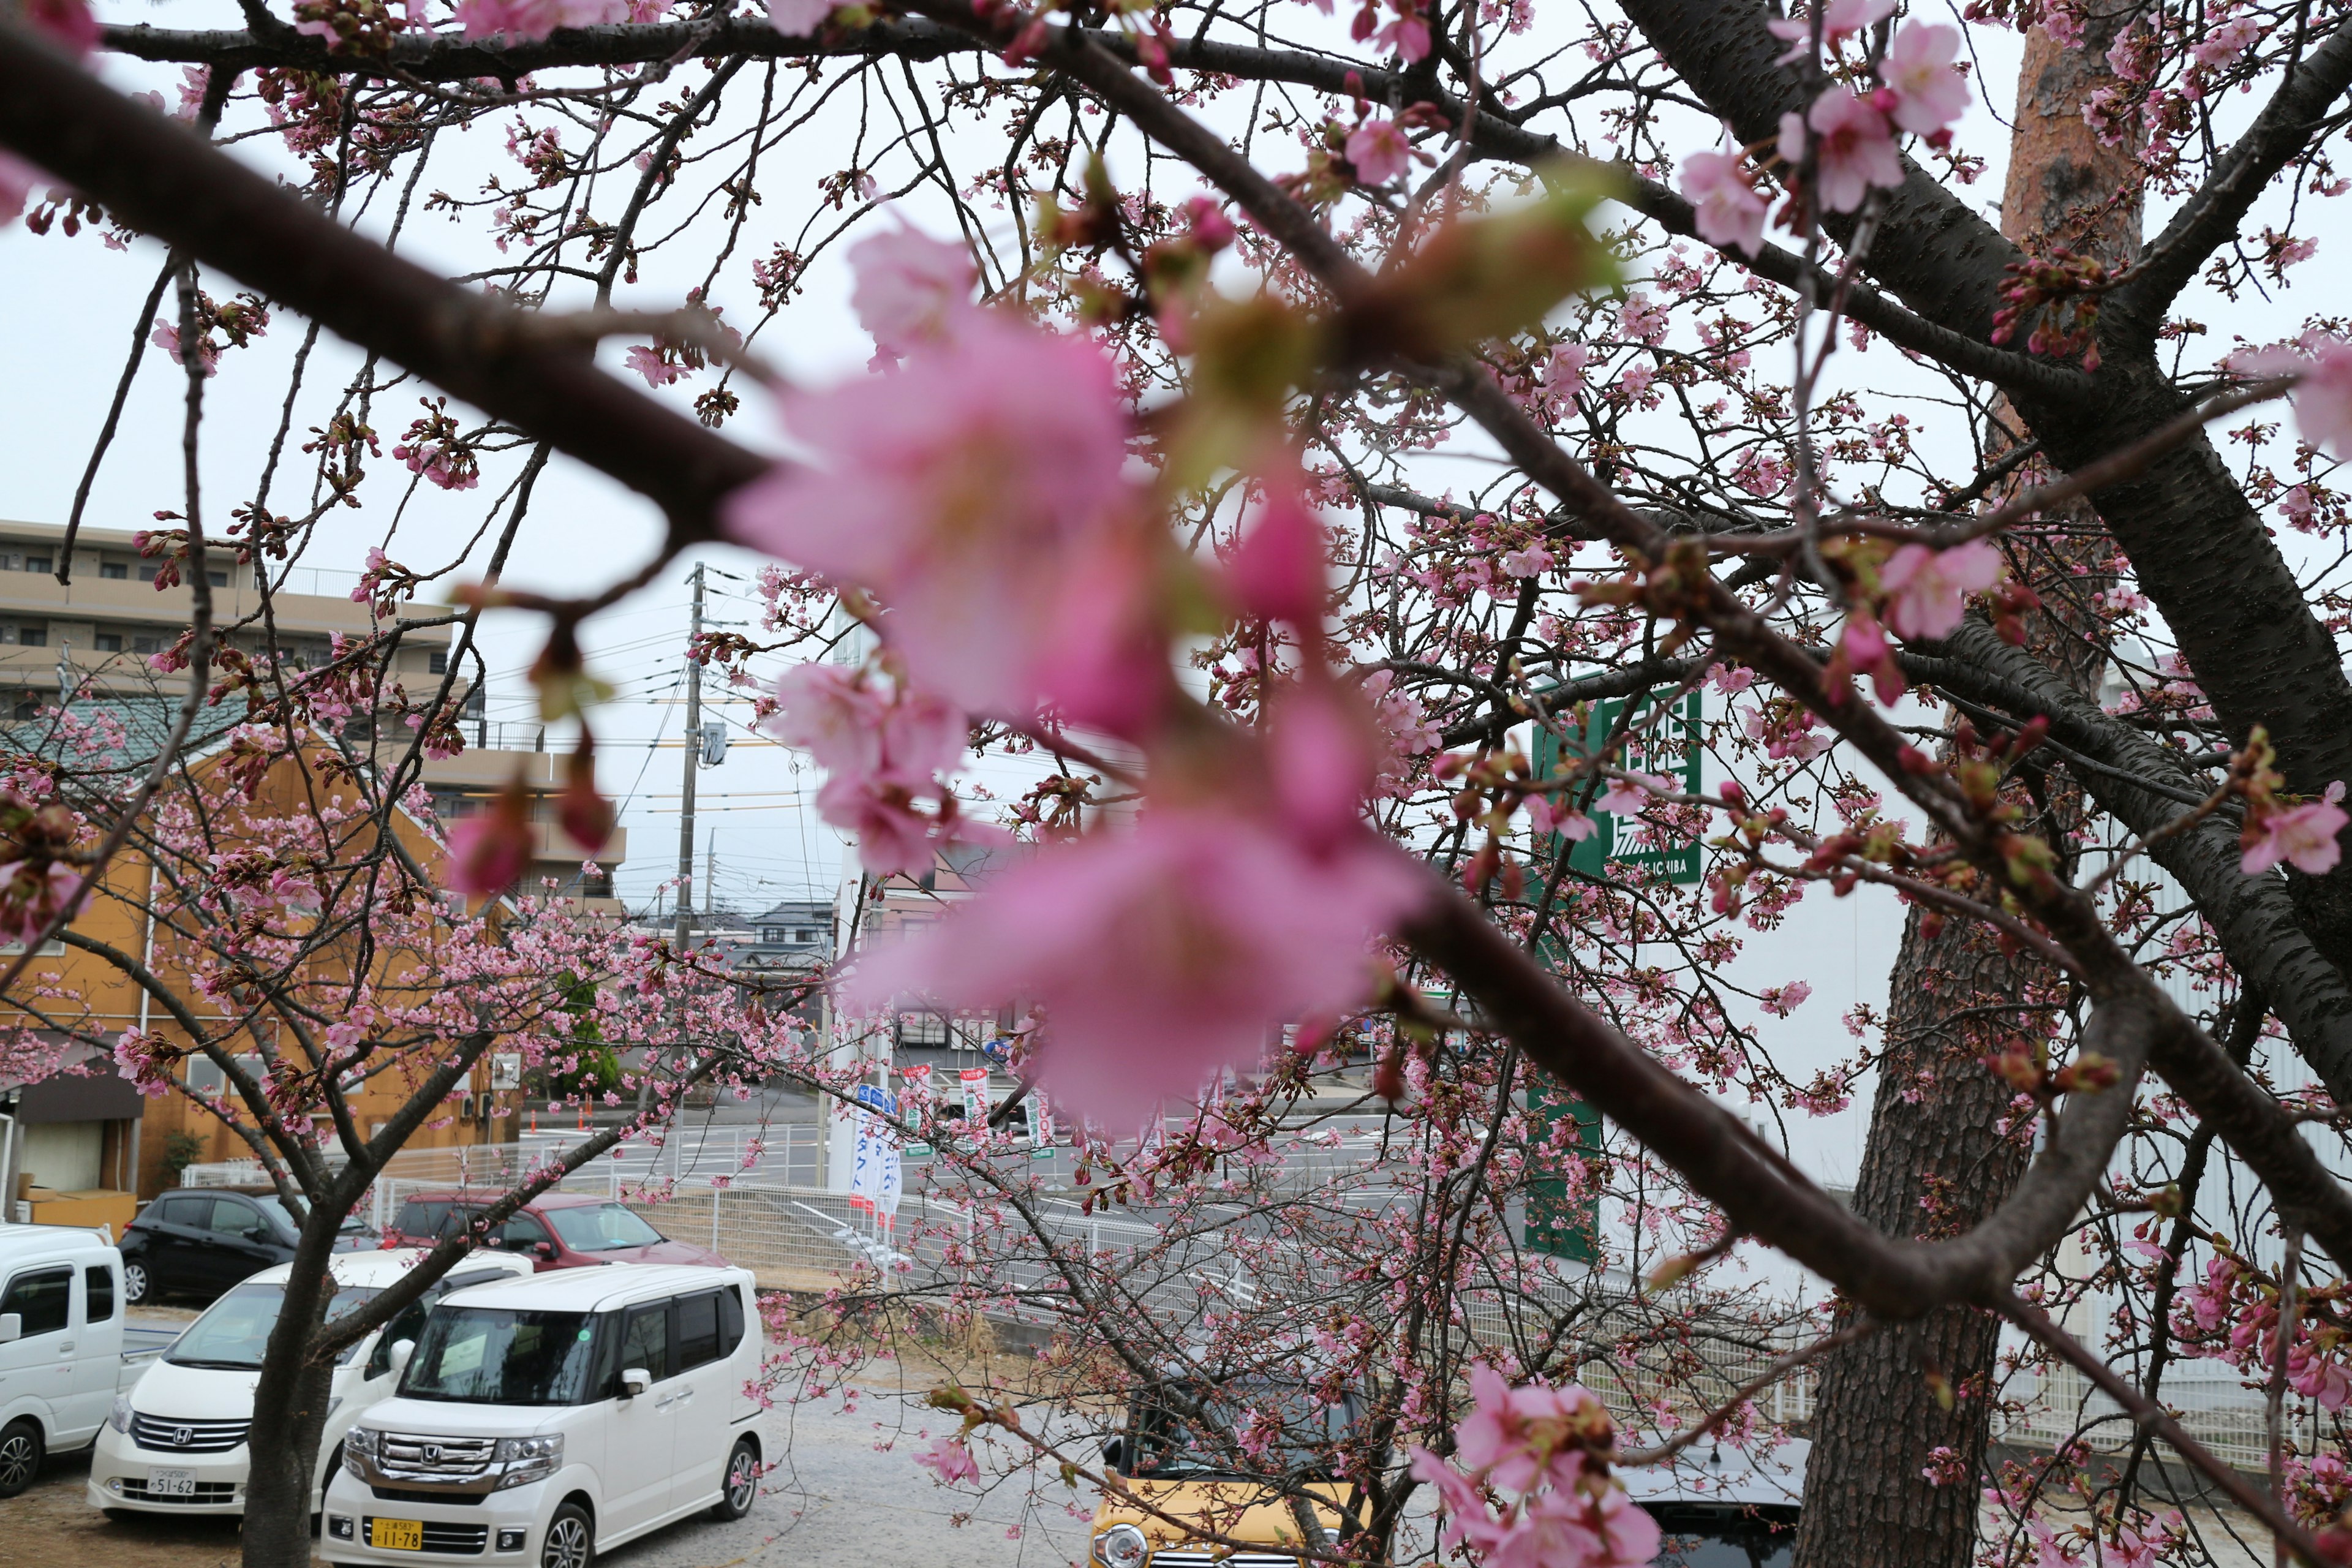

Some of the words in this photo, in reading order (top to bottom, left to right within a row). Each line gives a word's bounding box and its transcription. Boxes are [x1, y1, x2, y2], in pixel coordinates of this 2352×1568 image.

[1653, 859, 1687, 876] ICHIBA
[158, 1479, 192, 1493] 51-62
[384, 1531, 418, 1547] 11-78
